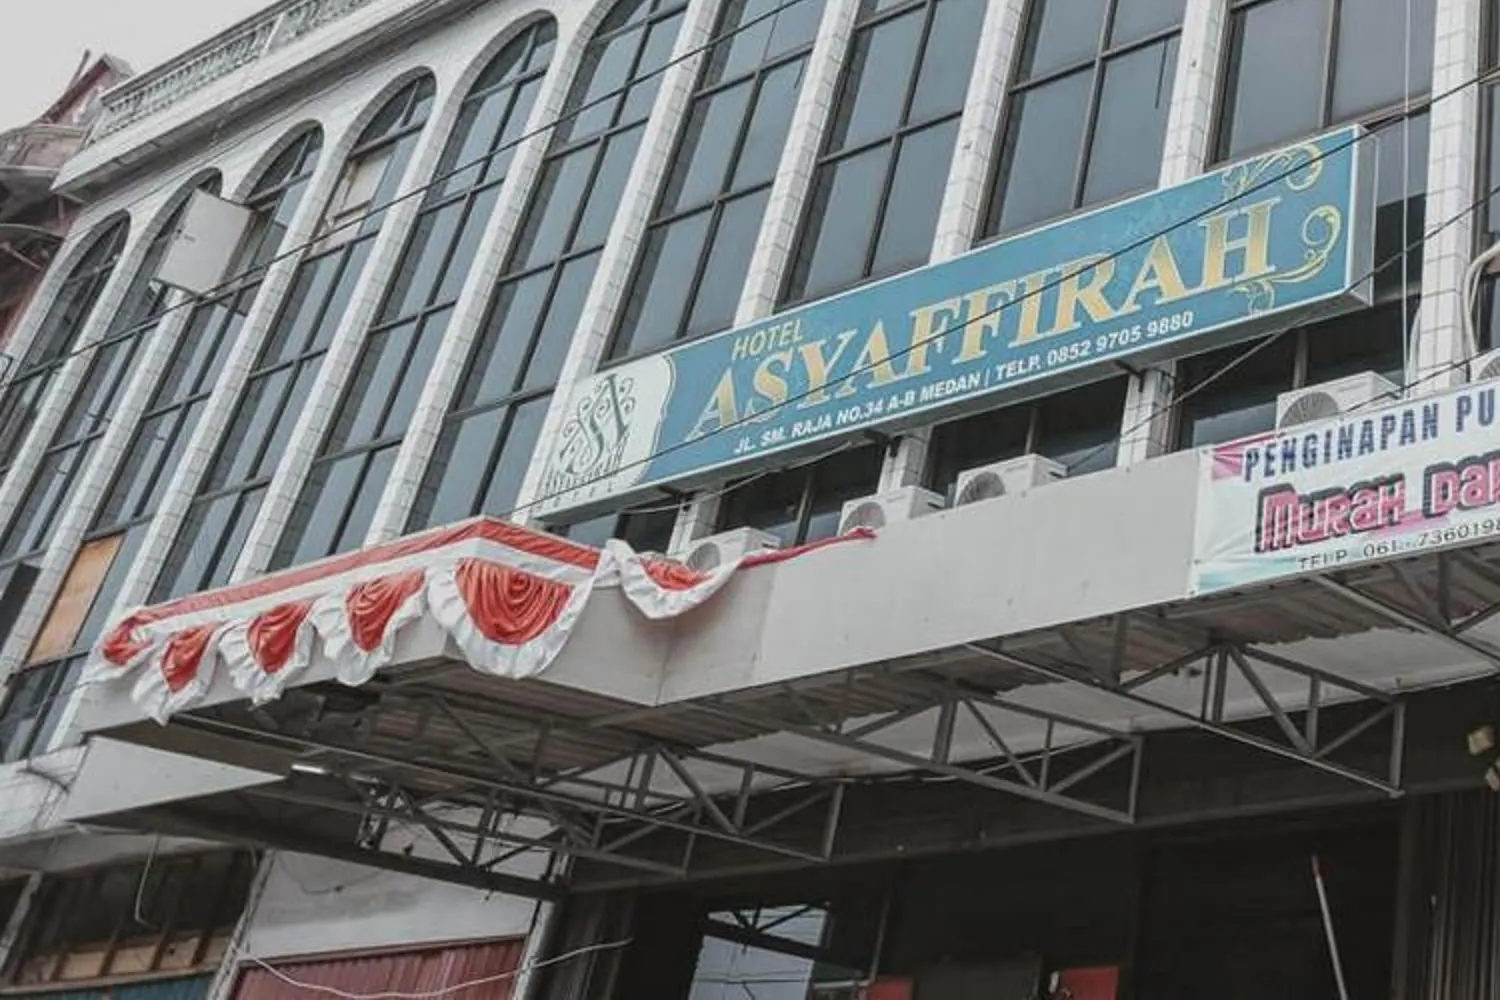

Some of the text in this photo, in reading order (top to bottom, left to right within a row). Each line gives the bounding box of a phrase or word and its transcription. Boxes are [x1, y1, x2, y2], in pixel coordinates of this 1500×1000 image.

[684, 197, 1281, 442] ASYAFFIRAH
[731, 319, 803, 361] HOTEL
[734, 437, 756, 455] JL.
[791, 413, 833, 439] RAJA
[835, 399, 884, 427] NO.34
[886, 390, 916, 413] A-B
[919, 372, 982, 404] MEDAN
[1047, 340, 1091, 366] 0852
[1096, 326, 1141, 352] 9705
[1147, 310, 1194, 338] 9880
[1244, 403, 1439, 482] PENGINAPAN
[1363, 539, 1397, 557] 061
